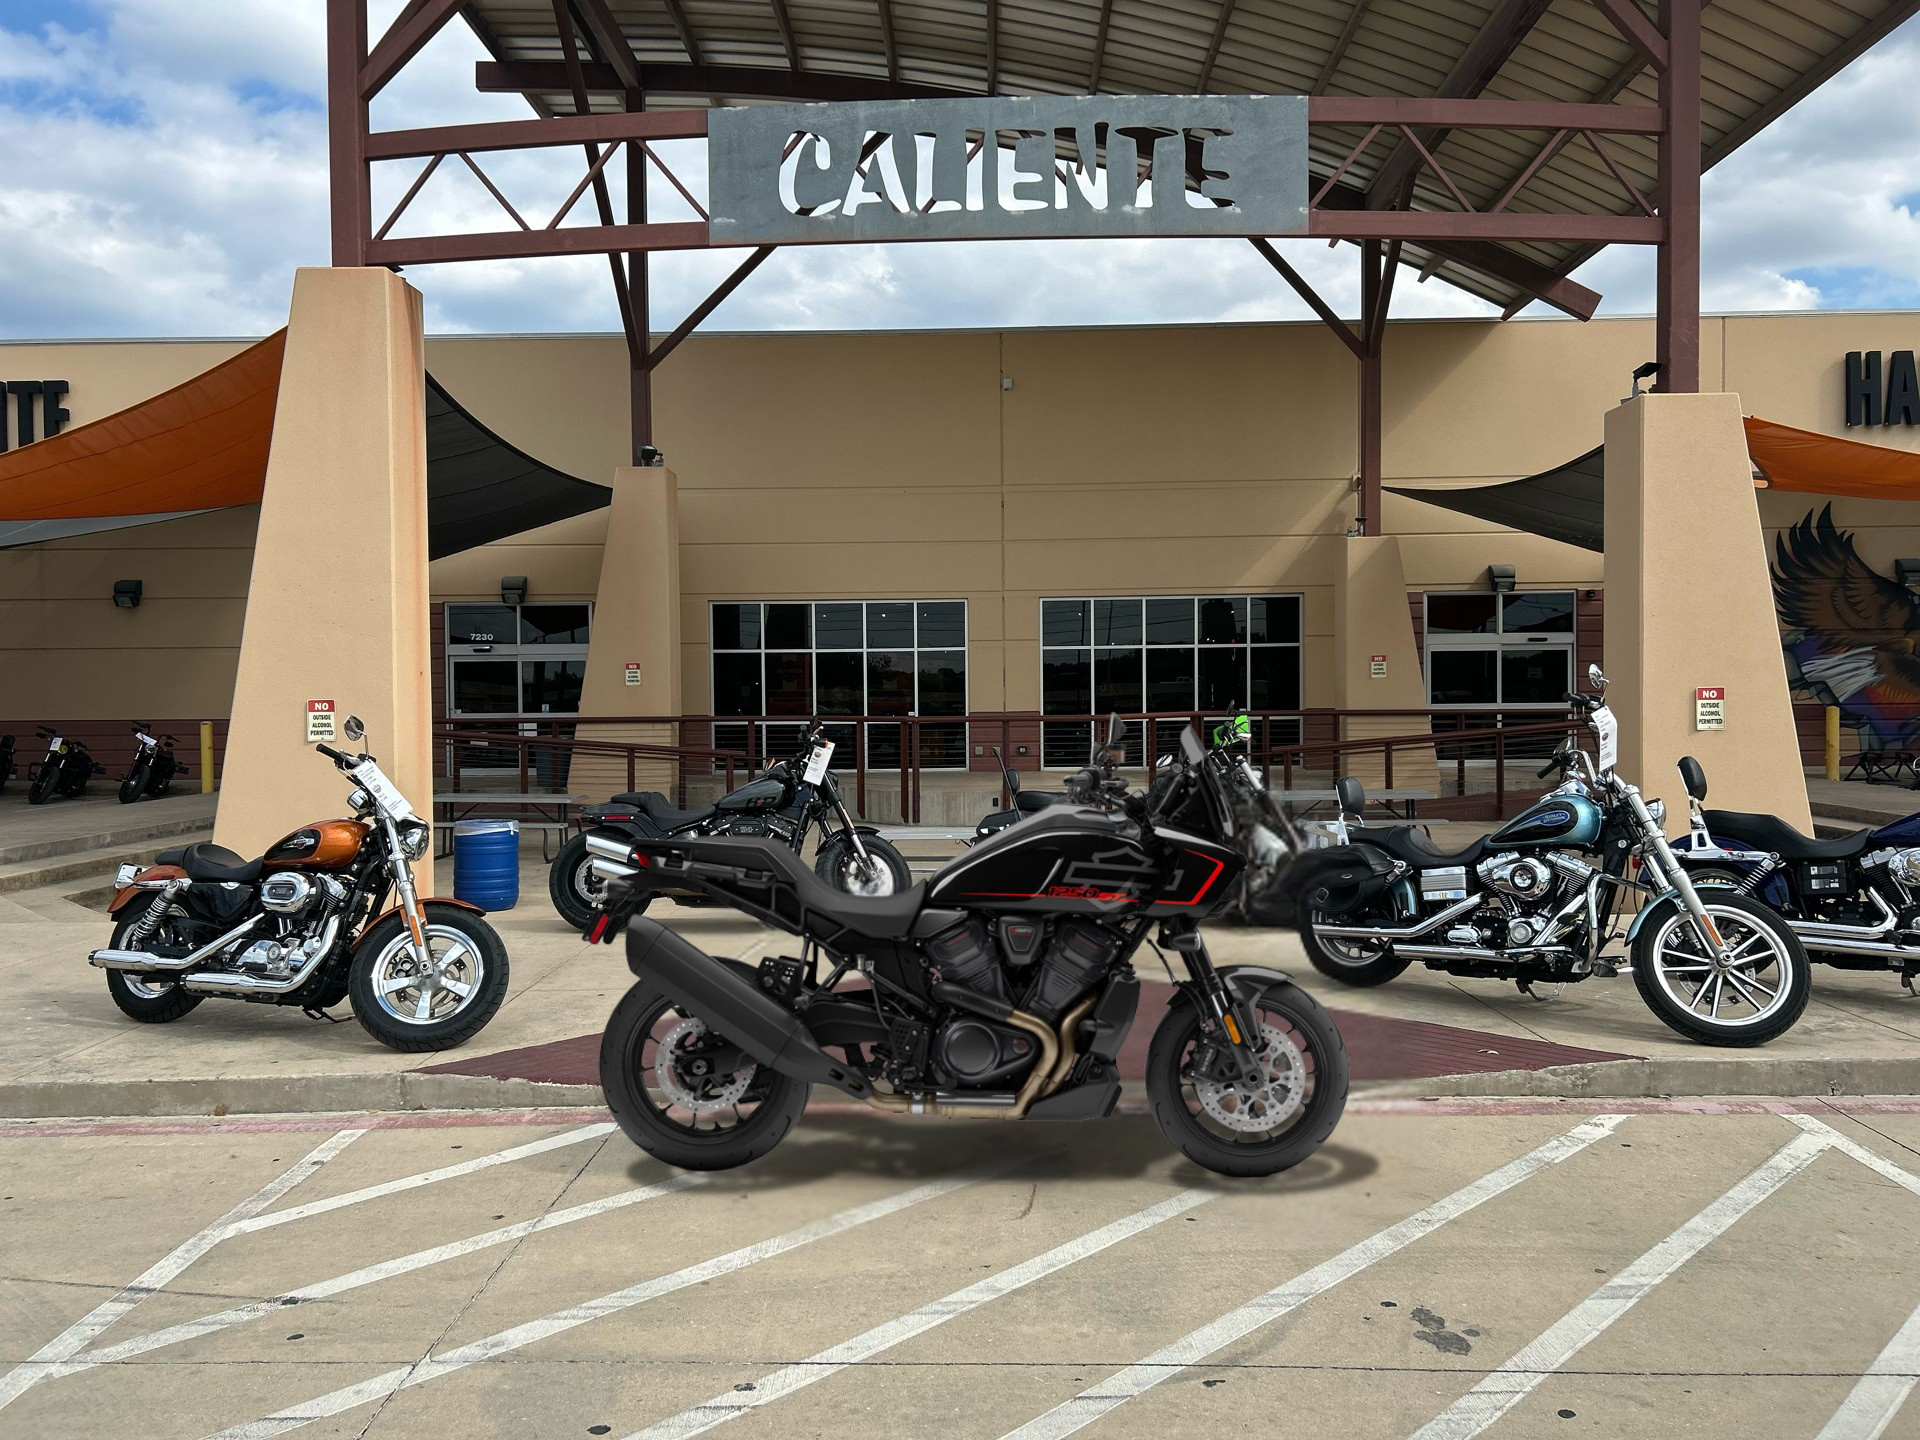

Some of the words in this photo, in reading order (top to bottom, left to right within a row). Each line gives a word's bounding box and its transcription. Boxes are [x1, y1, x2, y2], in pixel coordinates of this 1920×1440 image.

[778, 121, 1235, 217] CALIENTE
[470, 633, 494, 641] 7230
[1702, 690, 1718, 699] NO
[314, 702, 329, 711] NO
[1048, 886, 1099, 899] 1250
